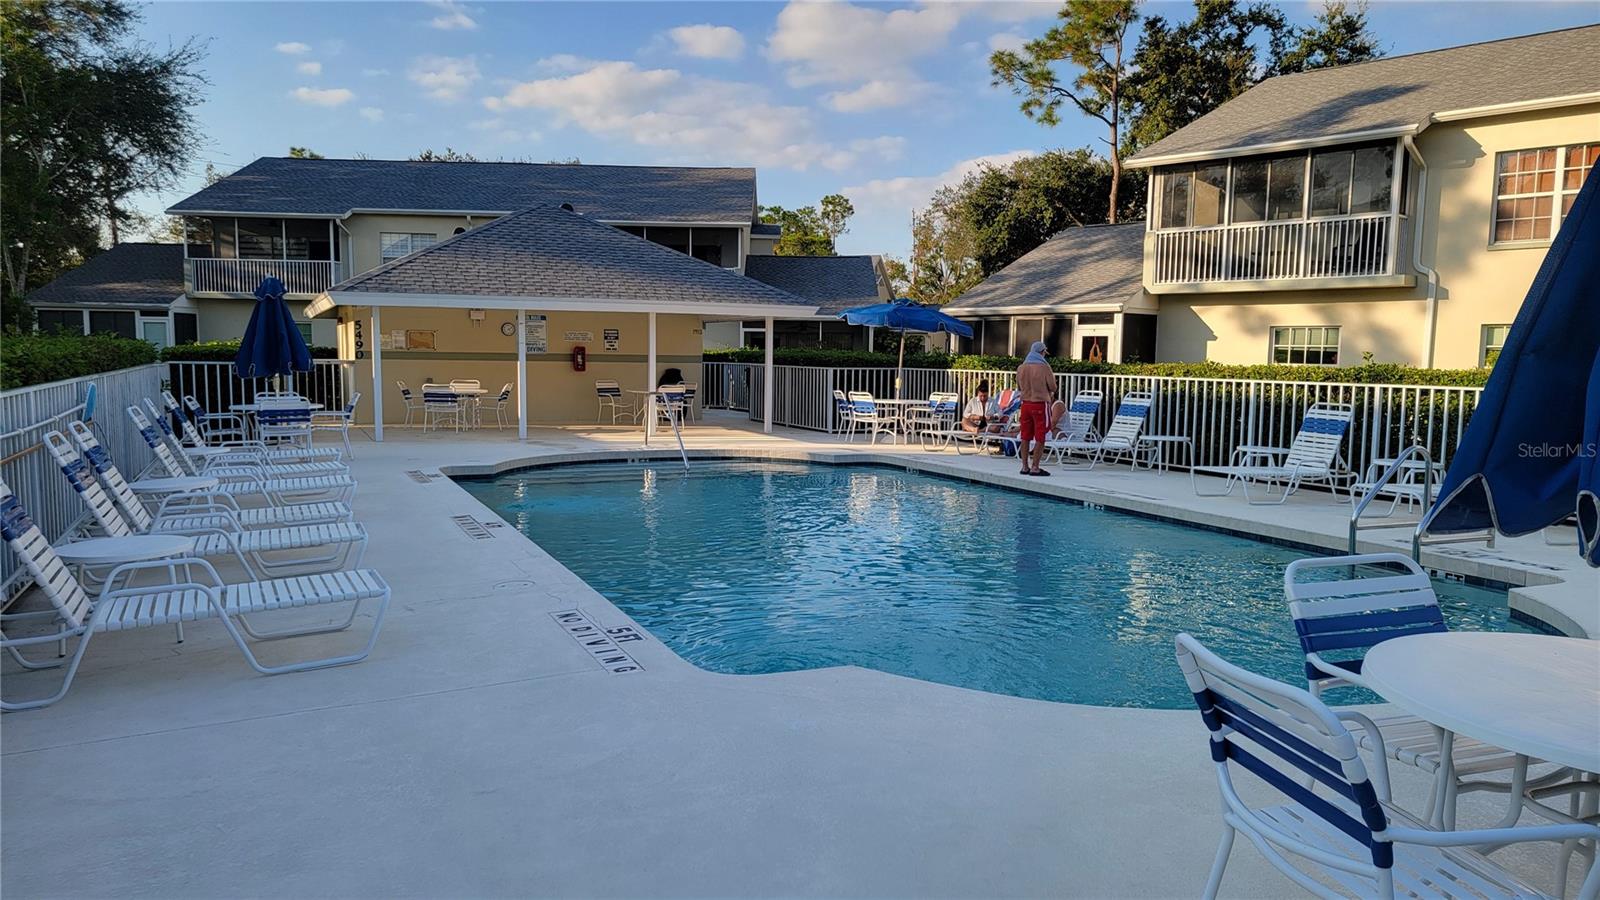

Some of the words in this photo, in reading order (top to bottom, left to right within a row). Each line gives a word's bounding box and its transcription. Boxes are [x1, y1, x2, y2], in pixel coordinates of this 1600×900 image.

[355, 319, 364, 360] 5490
[556, 612, 582, 623] NO
[570, 626, 637, 673] DIVING
